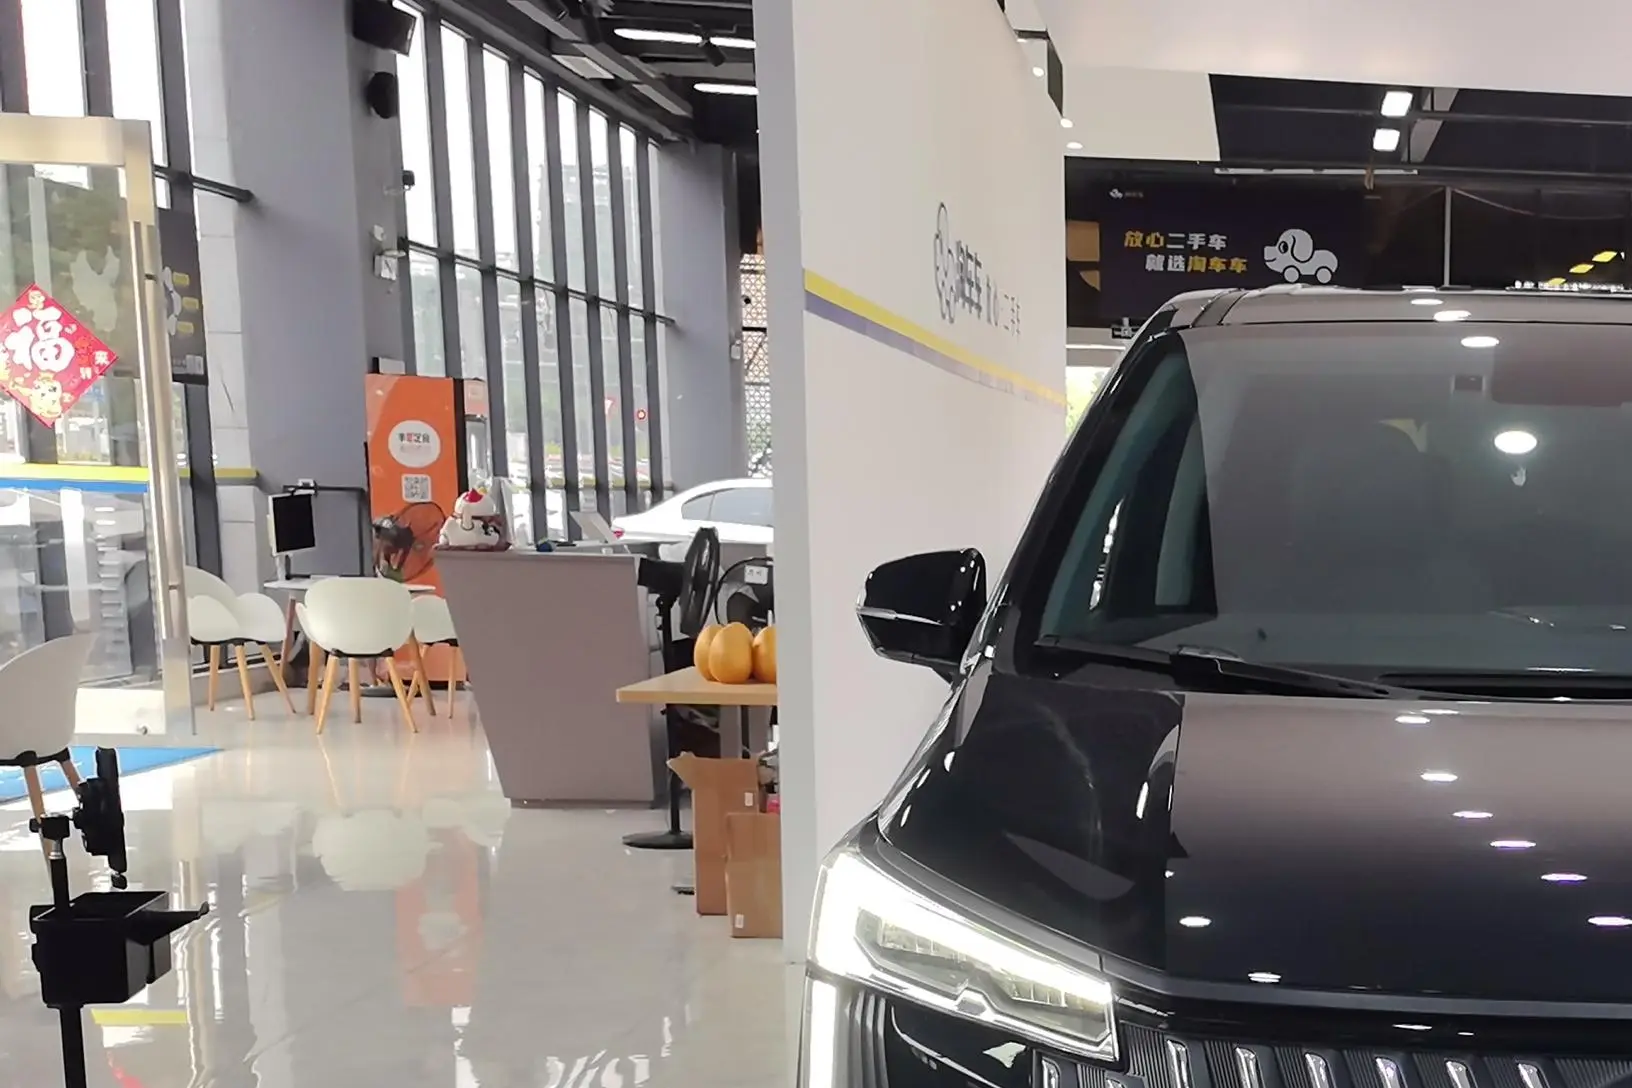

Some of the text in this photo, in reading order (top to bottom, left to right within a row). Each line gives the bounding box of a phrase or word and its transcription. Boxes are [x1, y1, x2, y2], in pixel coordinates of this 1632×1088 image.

[1123, 230, 1228, 250] 放心二手车
[1145, 254, 1248, 274] 就选淘车车
[4, 306, 75, 373] 福
